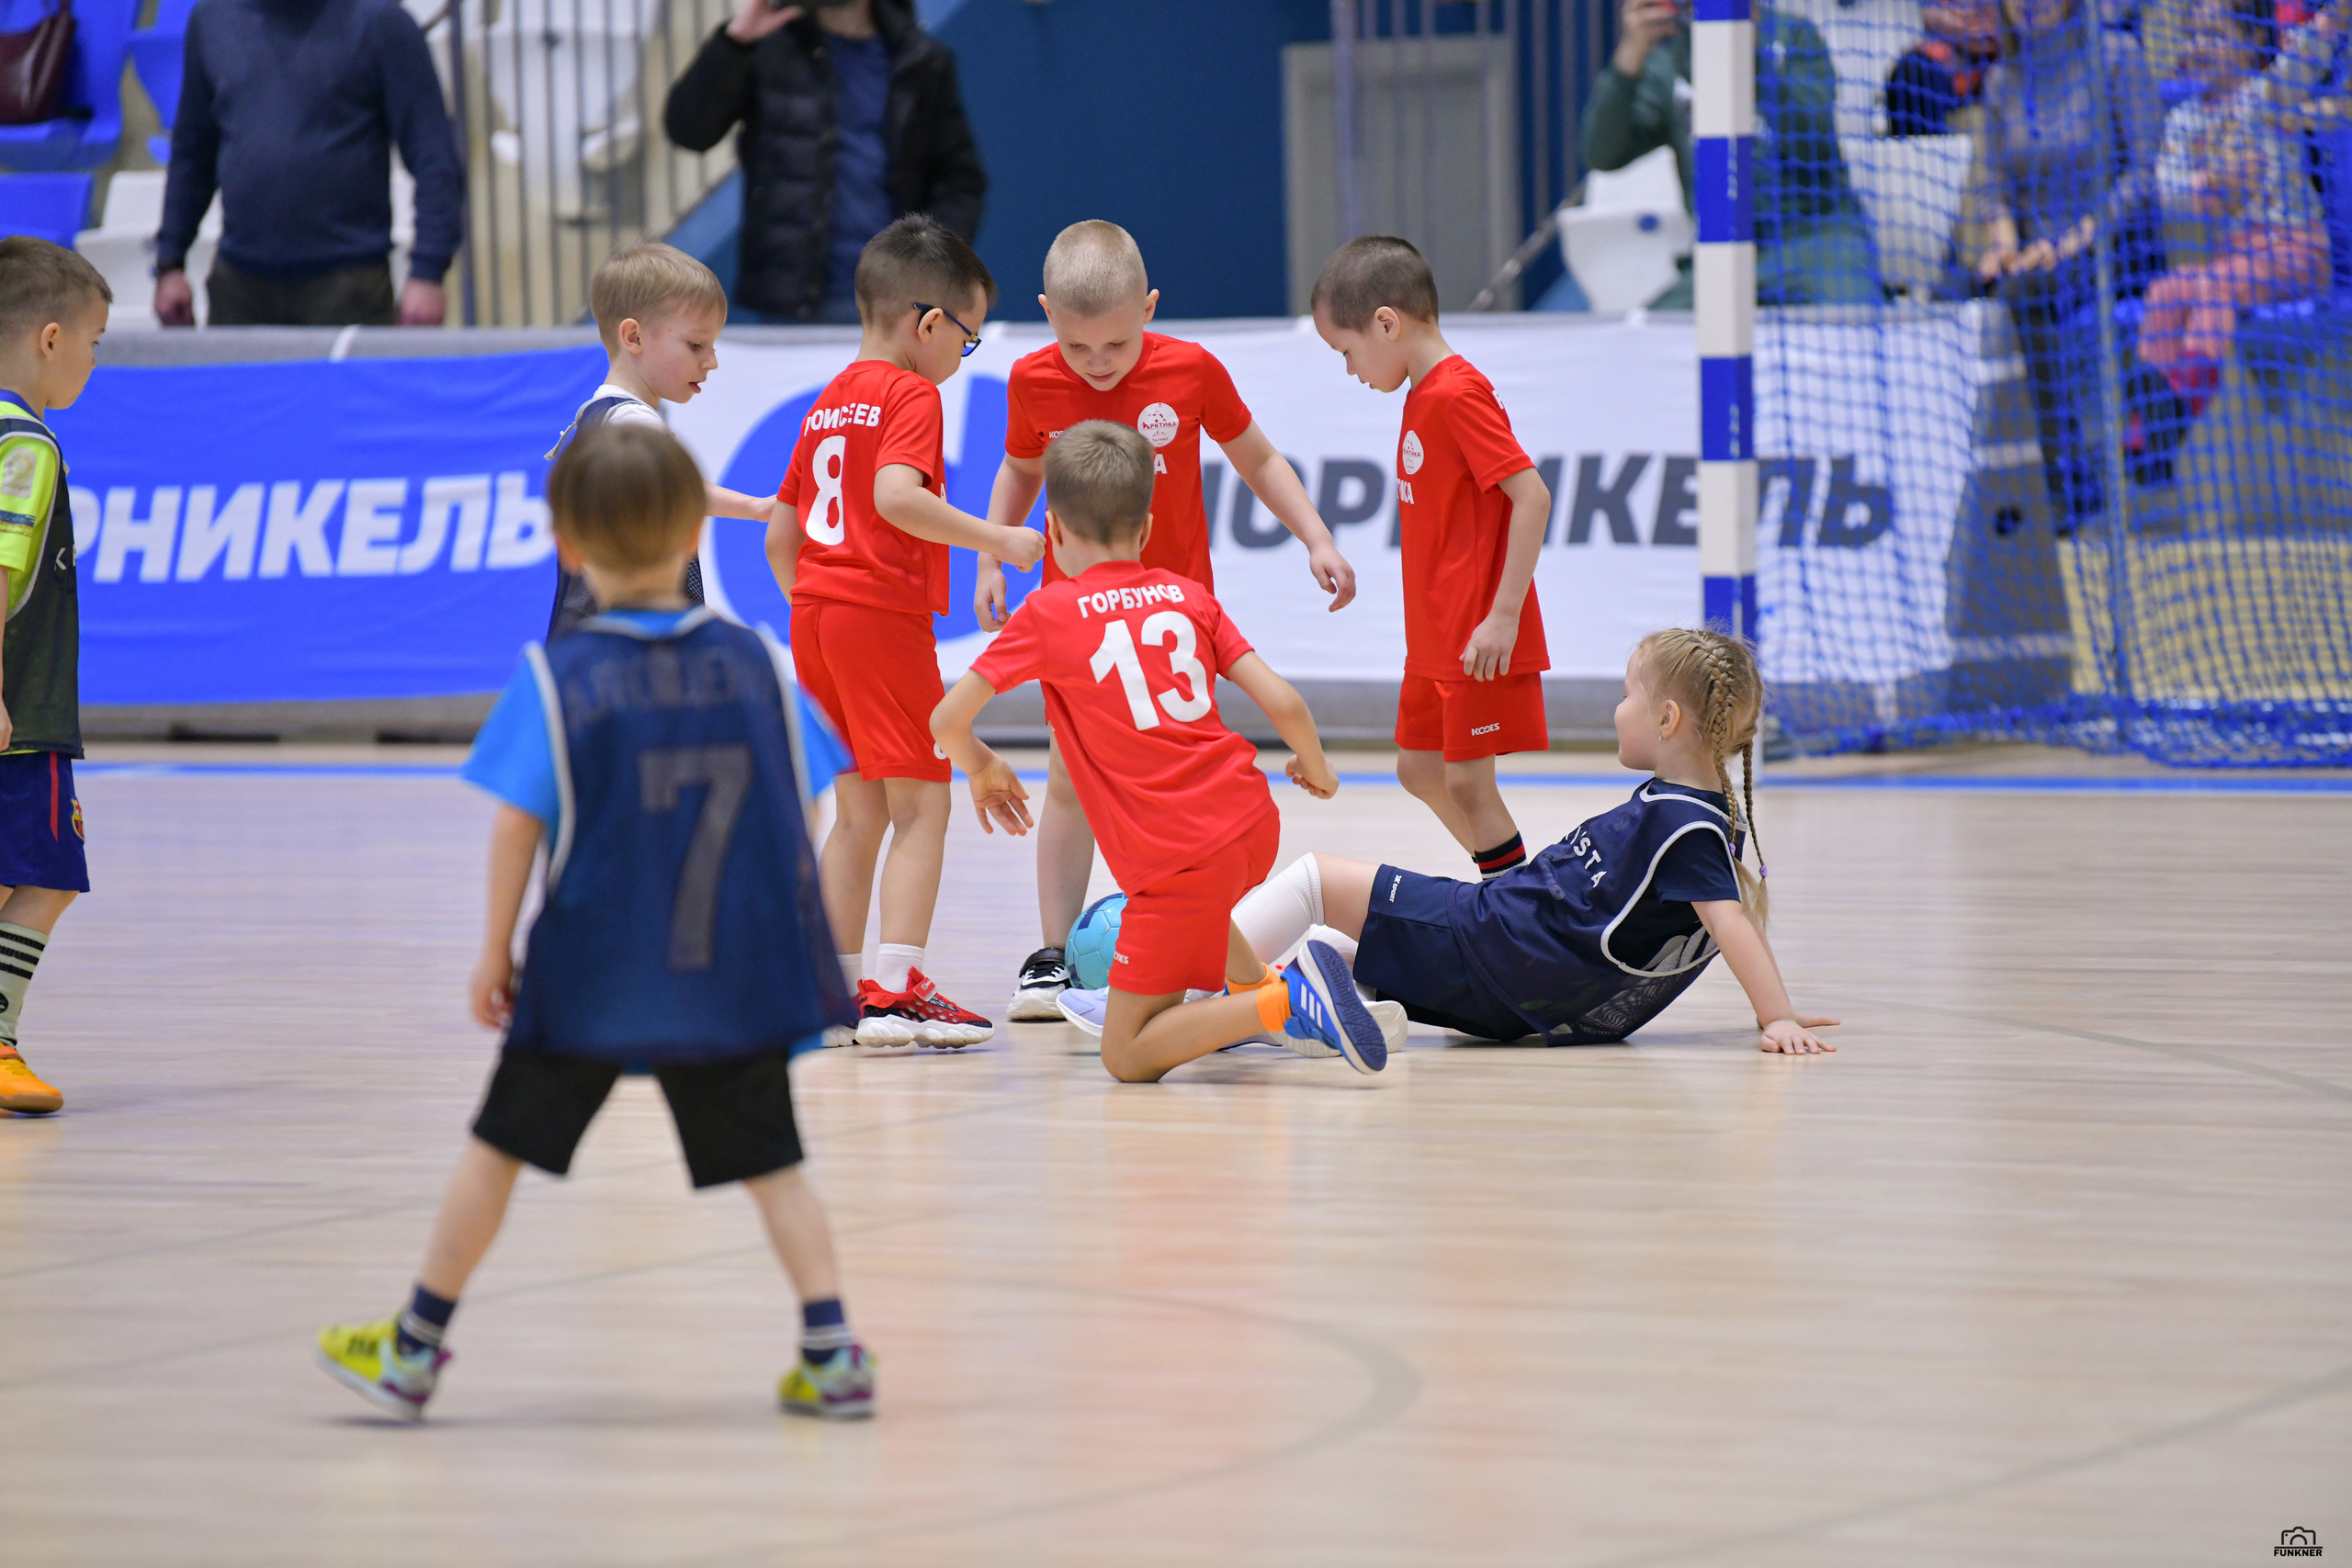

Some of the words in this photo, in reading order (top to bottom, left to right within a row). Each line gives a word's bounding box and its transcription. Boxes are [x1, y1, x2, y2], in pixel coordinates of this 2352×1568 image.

[806, 435, 846, 546] 8
[1077, 584, 1185, 619] ГОРБУНОВ
[1089, 610, 1212, 731] 13
[1471, 722, 1500, 736] KODES
[638, 744, 752, 972] 7
